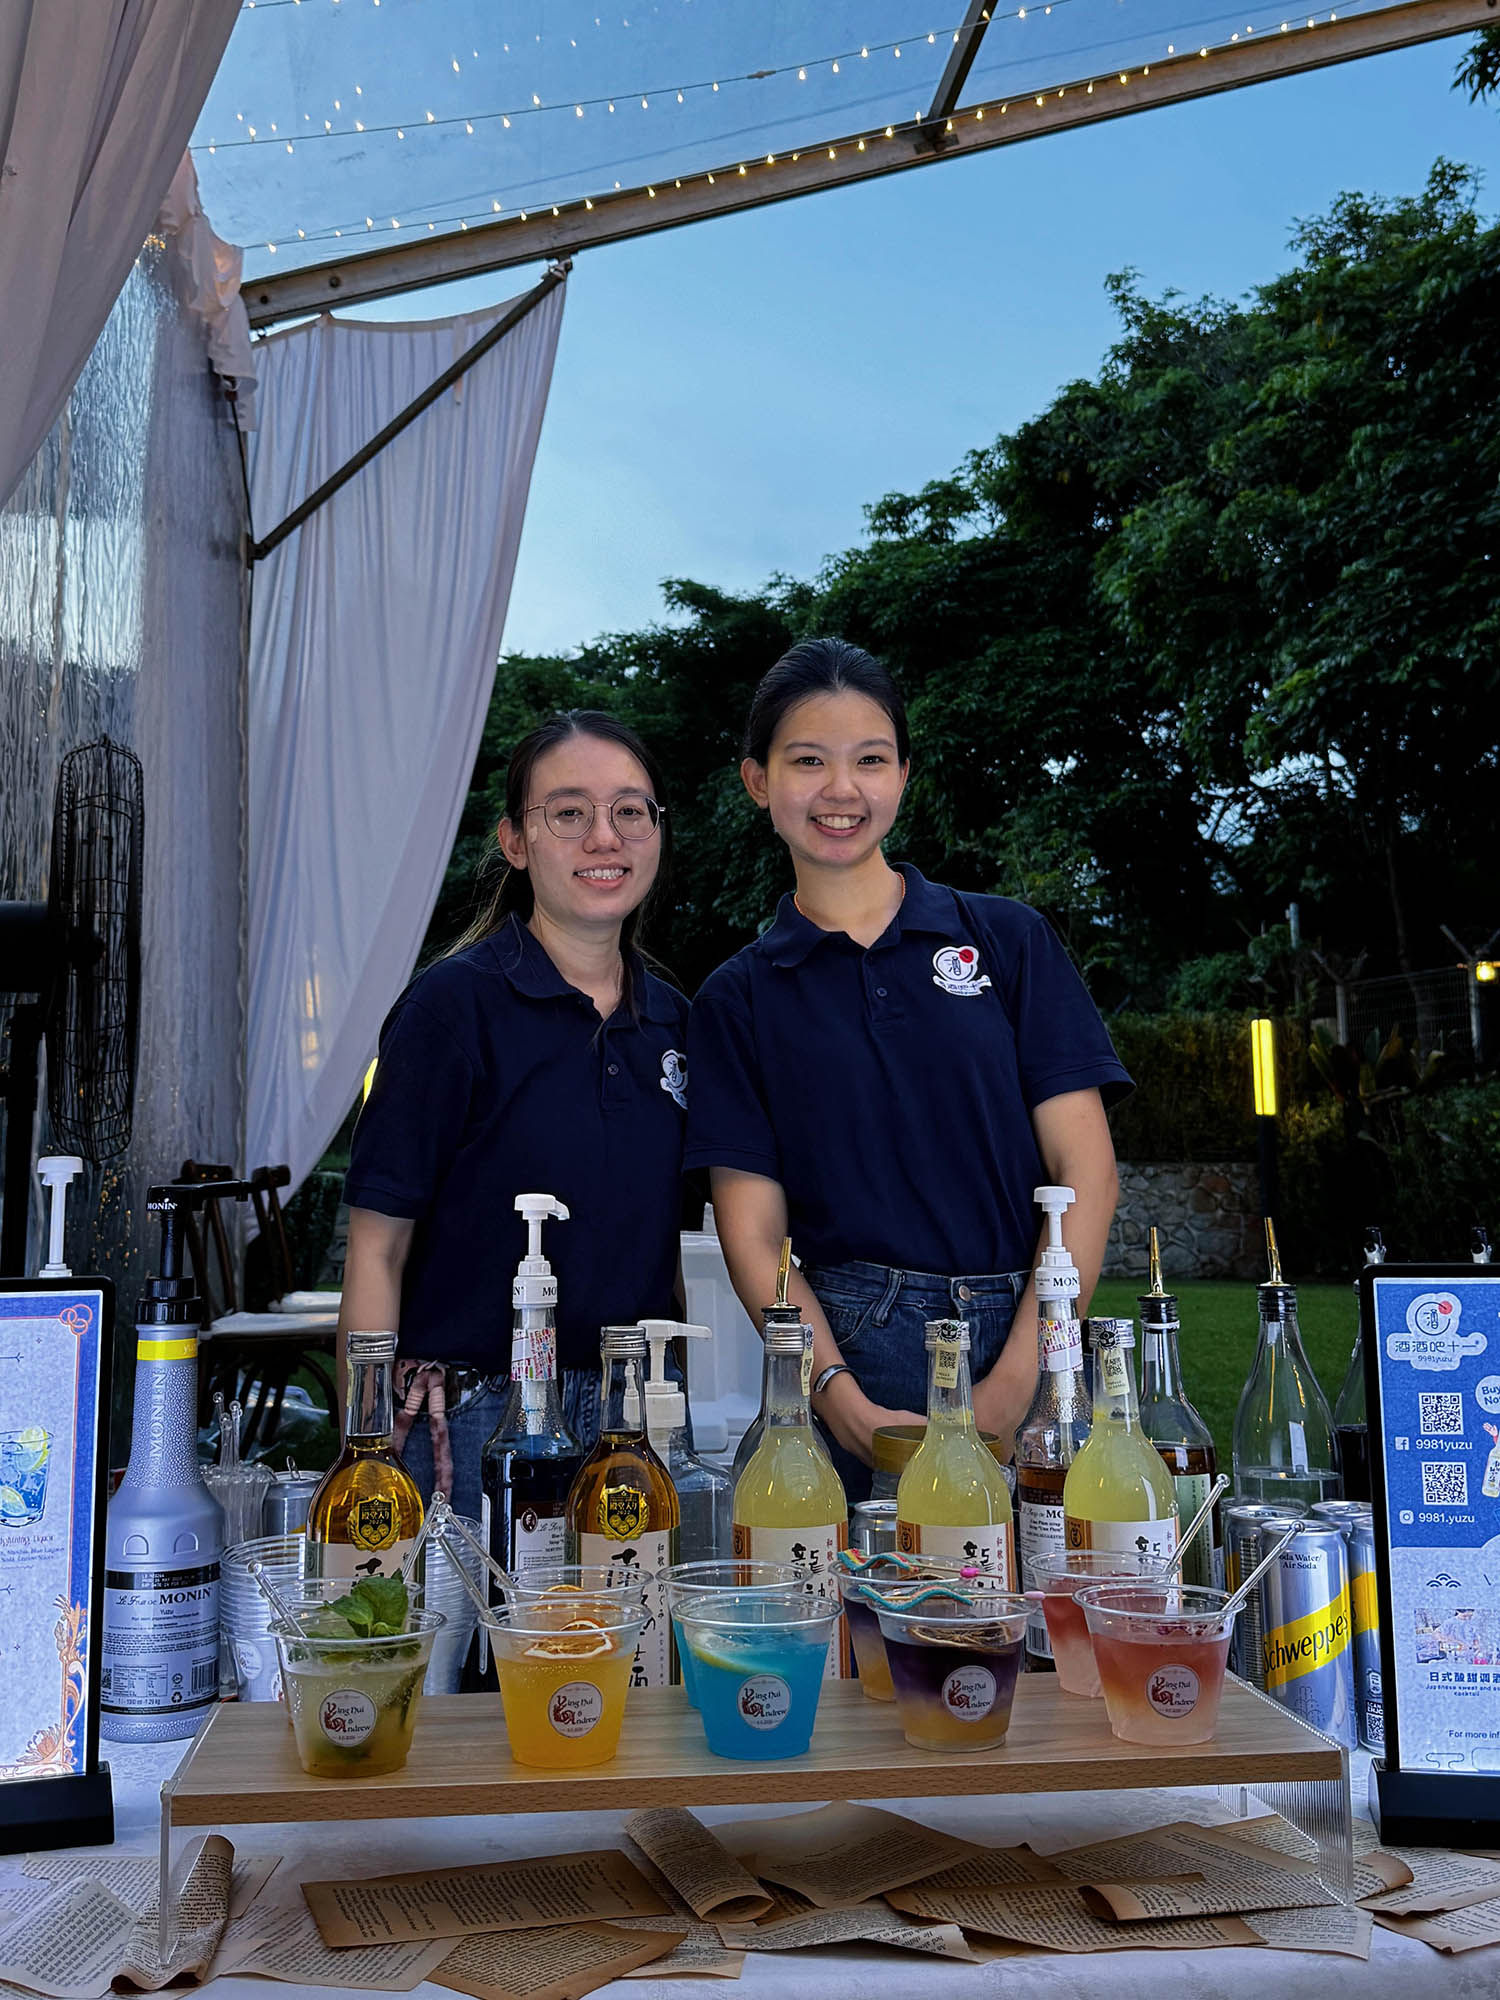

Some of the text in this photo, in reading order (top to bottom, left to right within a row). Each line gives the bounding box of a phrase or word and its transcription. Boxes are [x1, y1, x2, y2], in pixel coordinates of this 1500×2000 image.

[1415, 1438, 1473, 1452] 9981yuzu
[1418, 1512, 1476, 1525] 9981.yuzu
[1279, 1553, 1294, 1562] oda
[1297, 1561, 1317, 1570] Soda
[159, 1587, 211, 1605] MONIN
[1264, 1609, 1348, 1674] Schweppes
[1448, 1729, 1463, 1738] For
[1465, 1731, 1488, 1739] more
